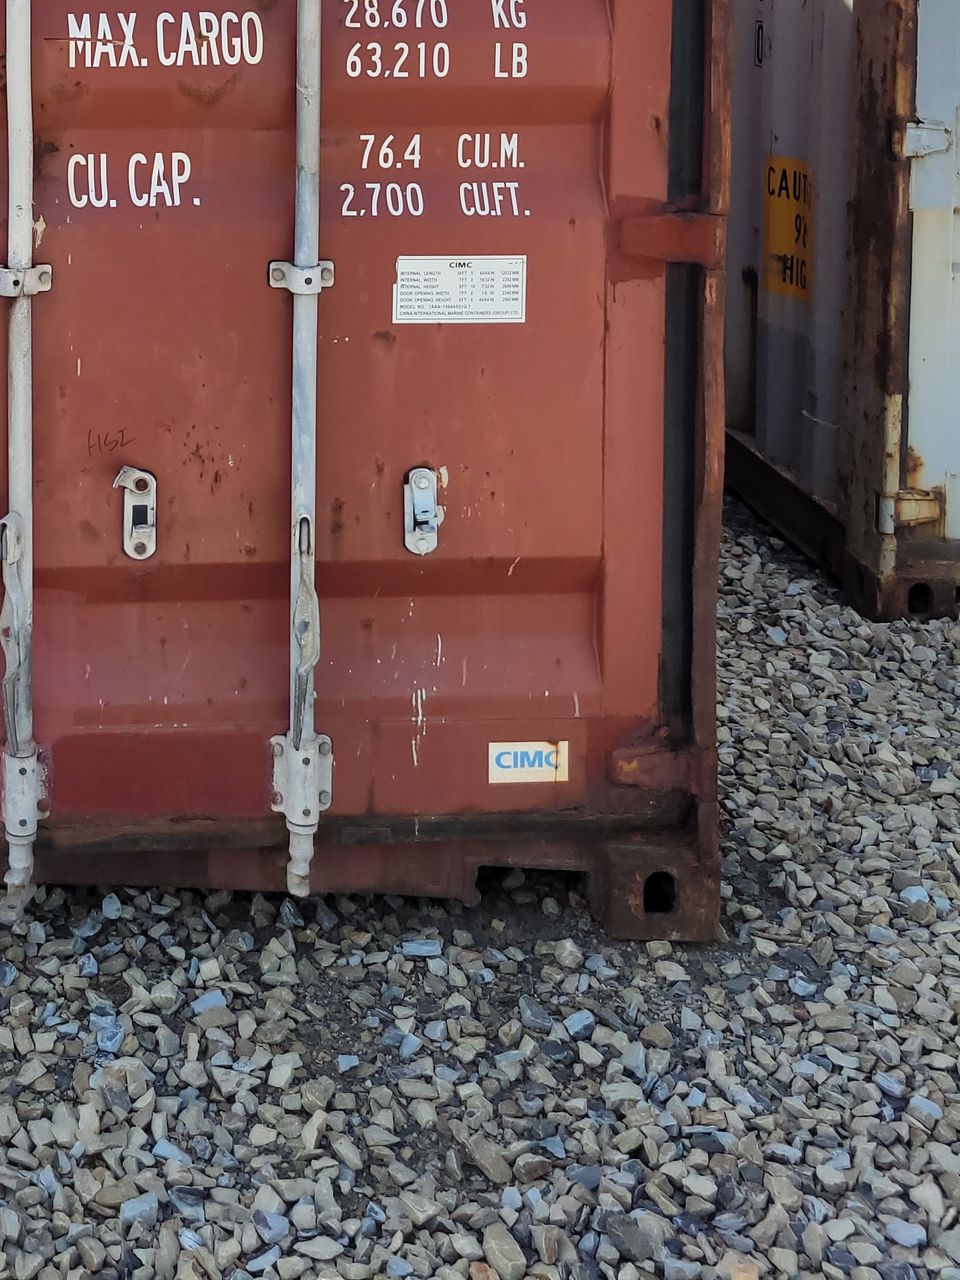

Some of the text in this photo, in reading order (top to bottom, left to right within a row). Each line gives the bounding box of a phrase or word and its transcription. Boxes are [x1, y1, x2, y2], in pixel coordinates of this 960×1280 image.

[67, 11, 264, 68] MAX. CARGO
[346, 42, 529, 78] 63,210 LB
[359, 133, 525, 169] 76.4 CU.M.
[67, 152, 201, 208] CU. CAP.
[340, 183, 424, 217] 2,700
[495, 750, 561, 769] CIMC
